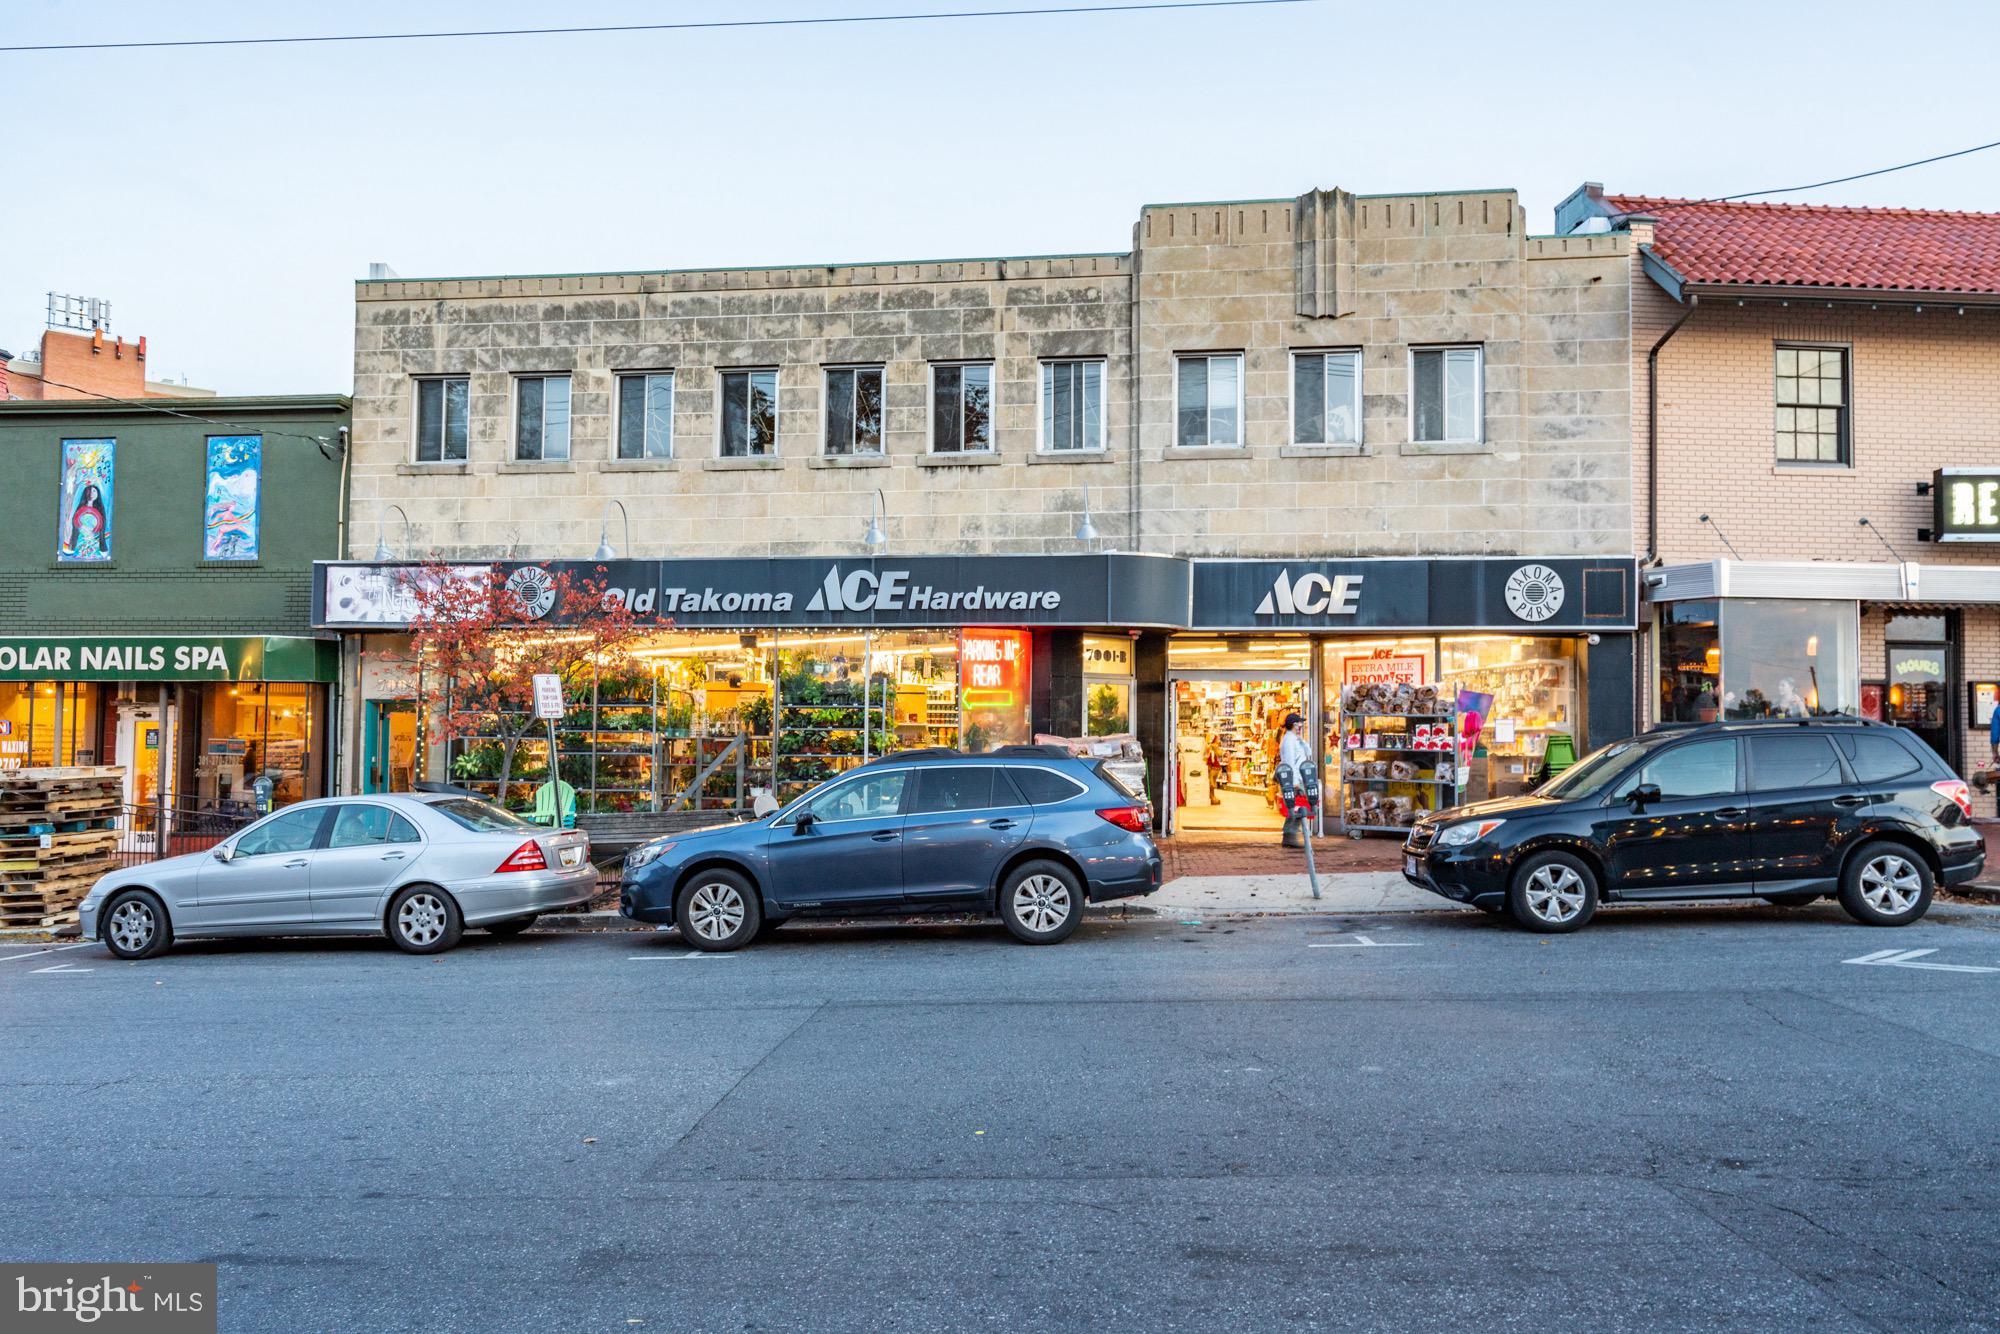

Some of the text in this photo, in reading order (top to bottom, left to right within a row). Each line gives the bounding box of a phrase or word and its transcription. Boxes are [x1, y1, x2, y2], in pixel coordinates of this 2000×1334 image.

[603, 564, 1061, 612] Old Takoma ACE Hardware
[1507, 566, 1563, 594] TAKOMA
[1254, 567, 1364, 614] ACE
[1515, 602, 1556, 619] PARK
[80, 646, 165, 671] NAILS
[174, 646, 228, 671] SPA
[962, 639, 1015, 661] PARKING IN
[1370, 648, 1393, 660] ACE
[973, 664, 1002, 687] REAR
[1351, 662, 1414, 673] EXTRA MILE
[1896, 659, 1940, 676] HOURS
[1351, 672, 1413, 684] PROMISE
[2, 741, 28, 753] WAXING
